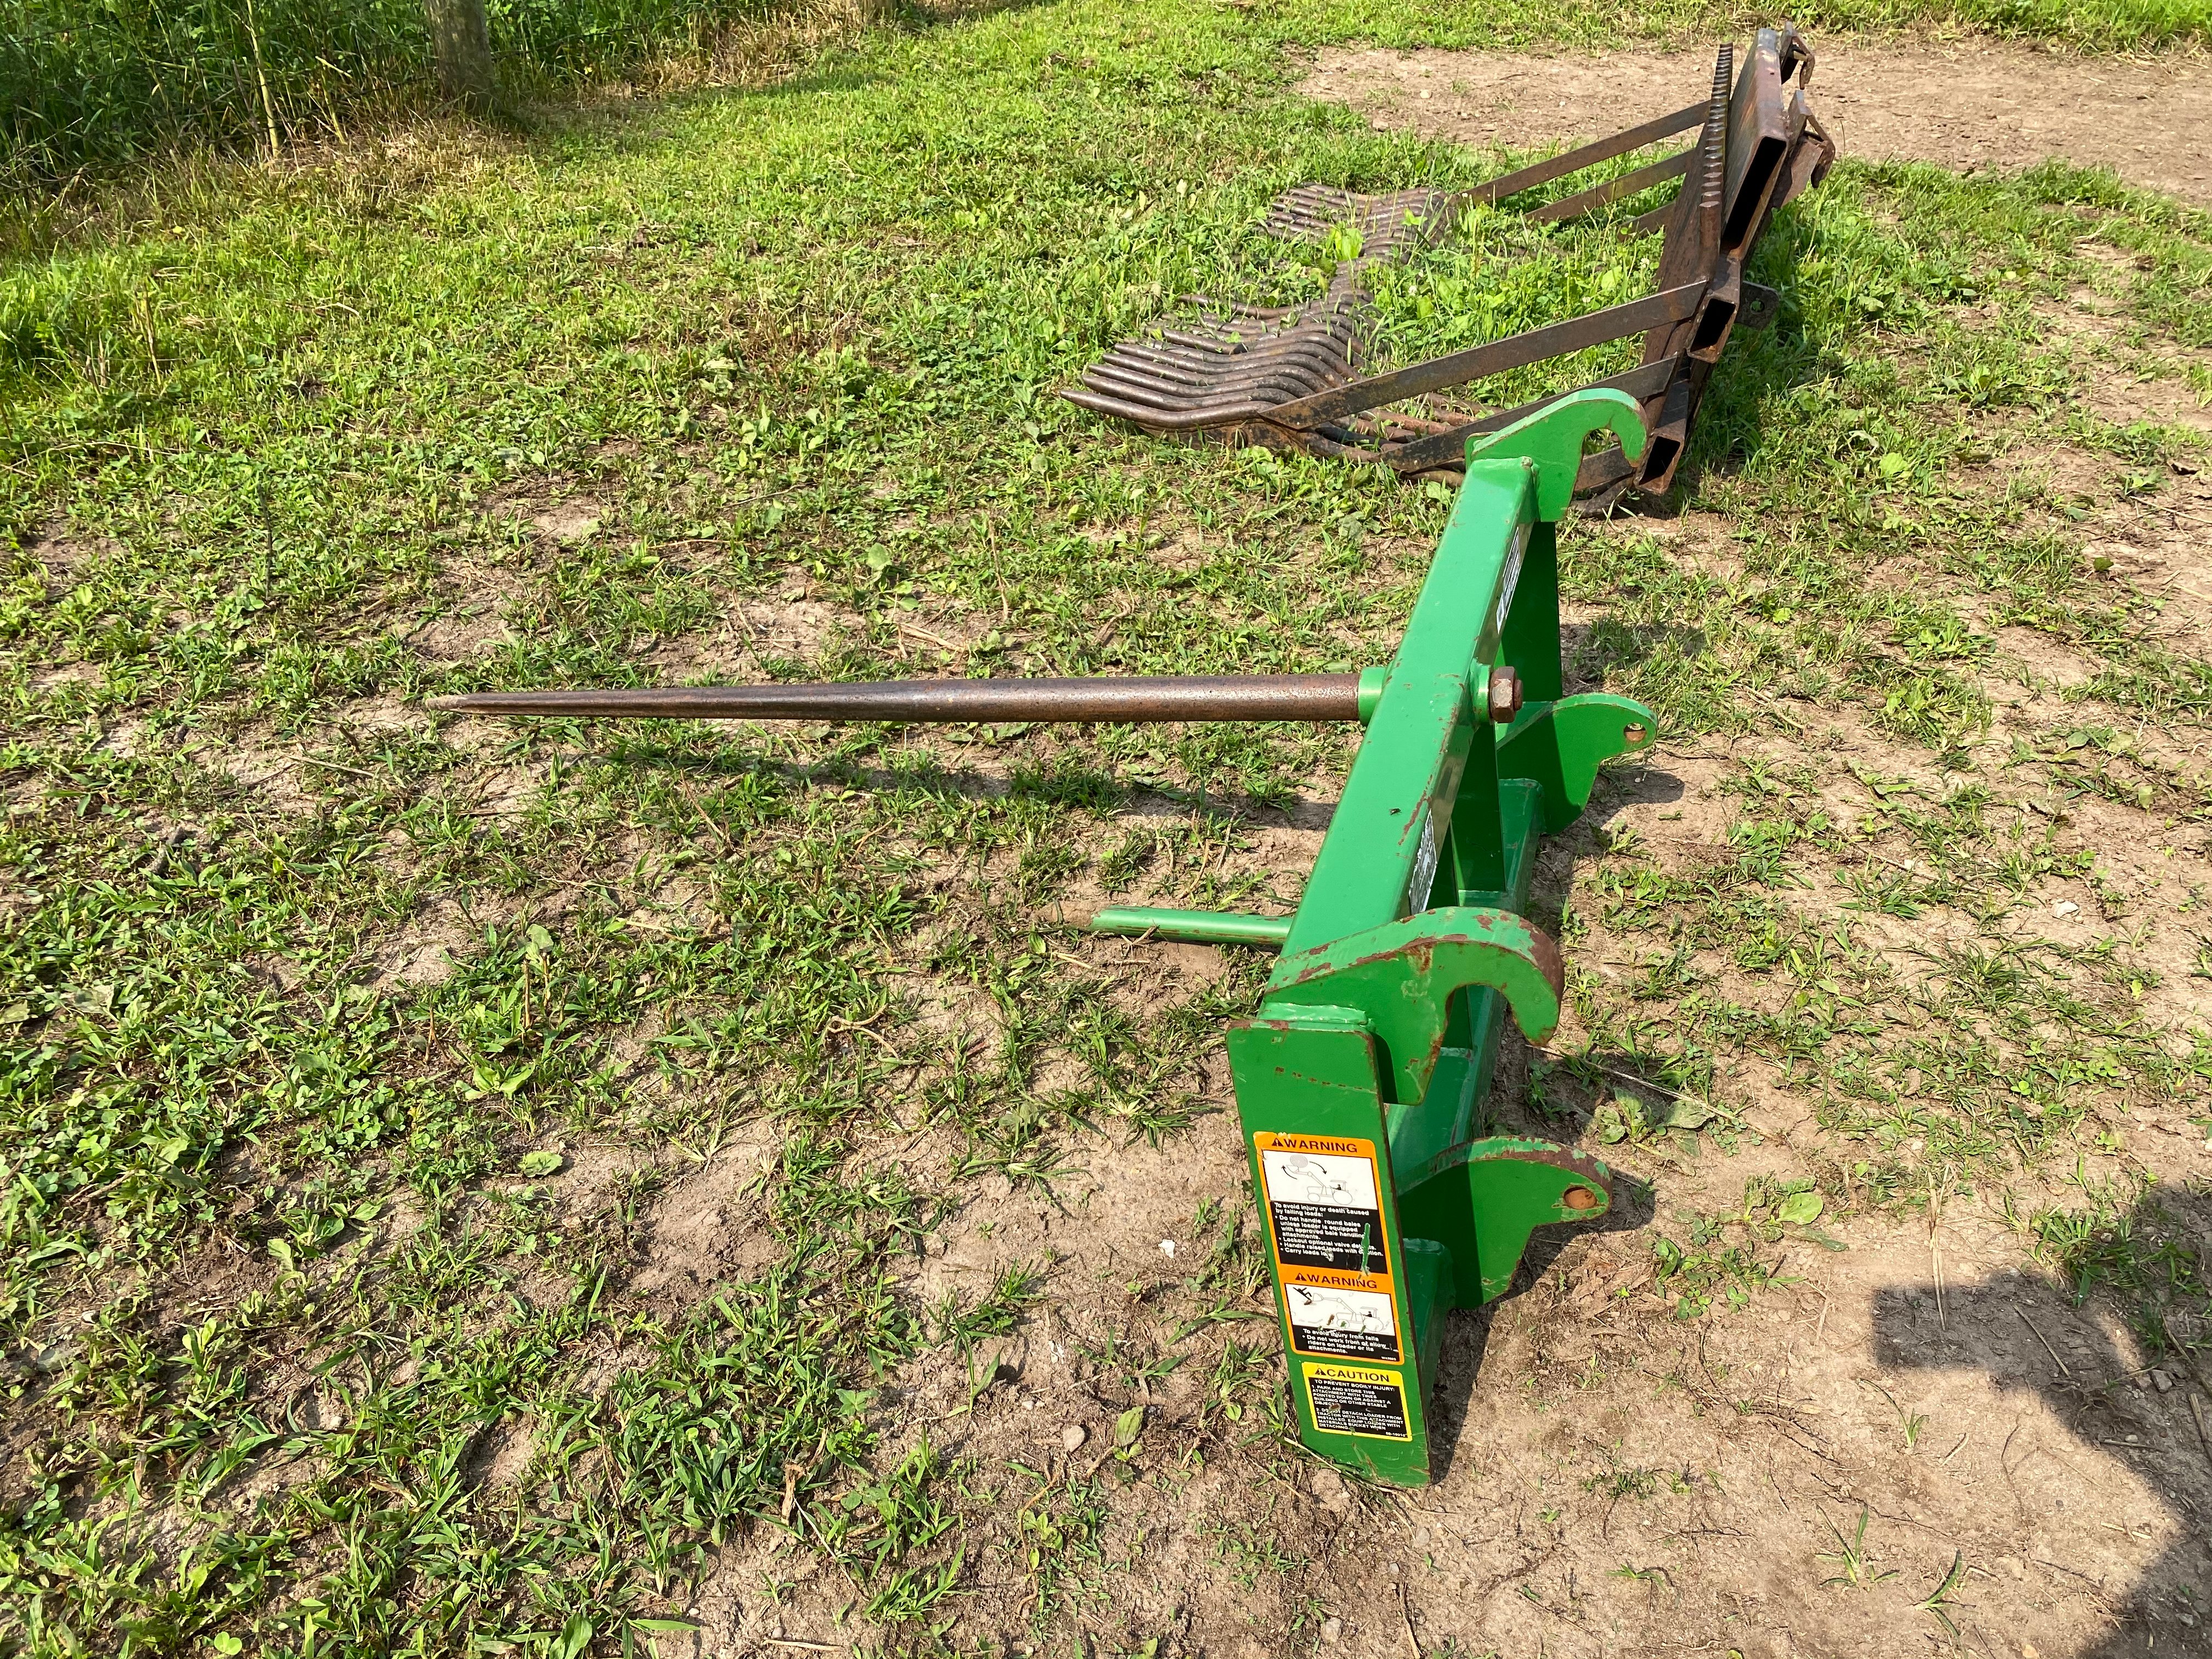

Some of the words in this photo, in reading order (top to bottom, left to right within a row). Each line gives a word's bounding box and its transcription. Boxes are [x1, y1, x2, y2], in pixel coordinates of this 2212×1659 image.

[1284, 1139, 1357, 1152] WARNING
[1307, 1273, 1377, 1288] WARNING
[1308, 1345, 1347, 1353] attachments.
[1327, 1369, 1389, 1382] CAUTION
